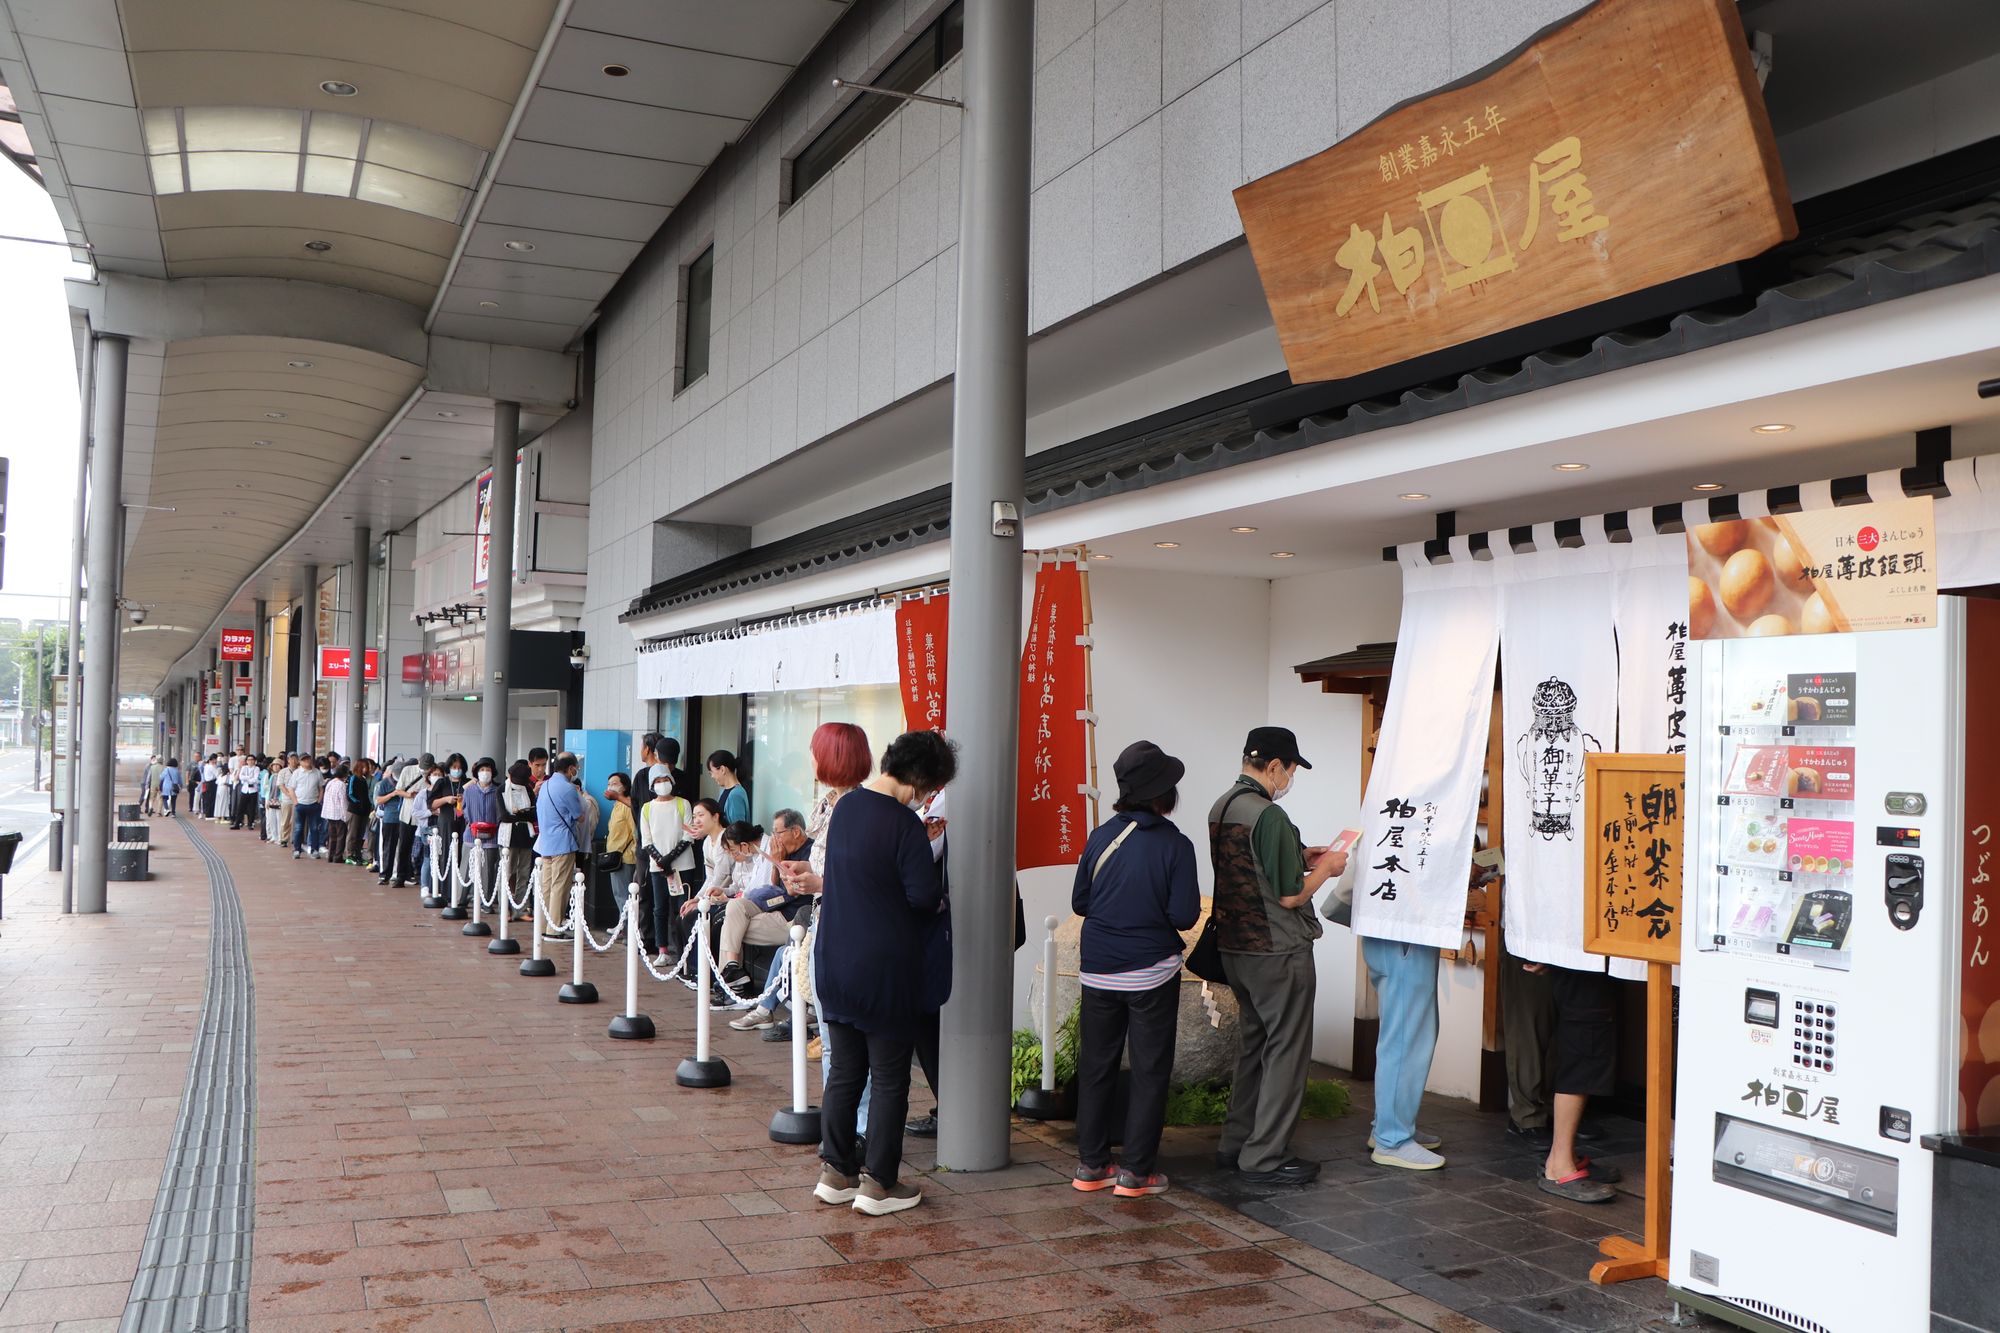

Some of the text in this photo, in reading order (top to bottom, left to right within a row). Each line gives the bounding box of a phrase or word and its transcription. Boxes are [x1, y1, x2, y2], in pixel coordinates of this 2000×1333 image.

[1378, 105, 1507, 184] 創業嘉永五年
[1834, 527, 1925, 548] 日本三大まんじゅう
[1798, 551, 1927, 581] 柏屋薄皮饅頭
[1888, 585, 1927, 595] ふくしま名物
[223, 635, 253, 644] カラオケ
[1797, 686, 1847, 695] うすかわまんじゅう
[1798, 758, 1848, 767] うすかわまんじゅう
[1540, 745, 1564, 815] 御菓子
[1370, 797, 1417, 902] 柏屋本店
[1416, 801, 1439, 872] 創業嘉永五年
[1635, 783, 1678, 940] 朝茶会
[1970, 823, 1992, 968] つぶあん
[1772, 1066, 1820, 1084] 創業嘉永五年
